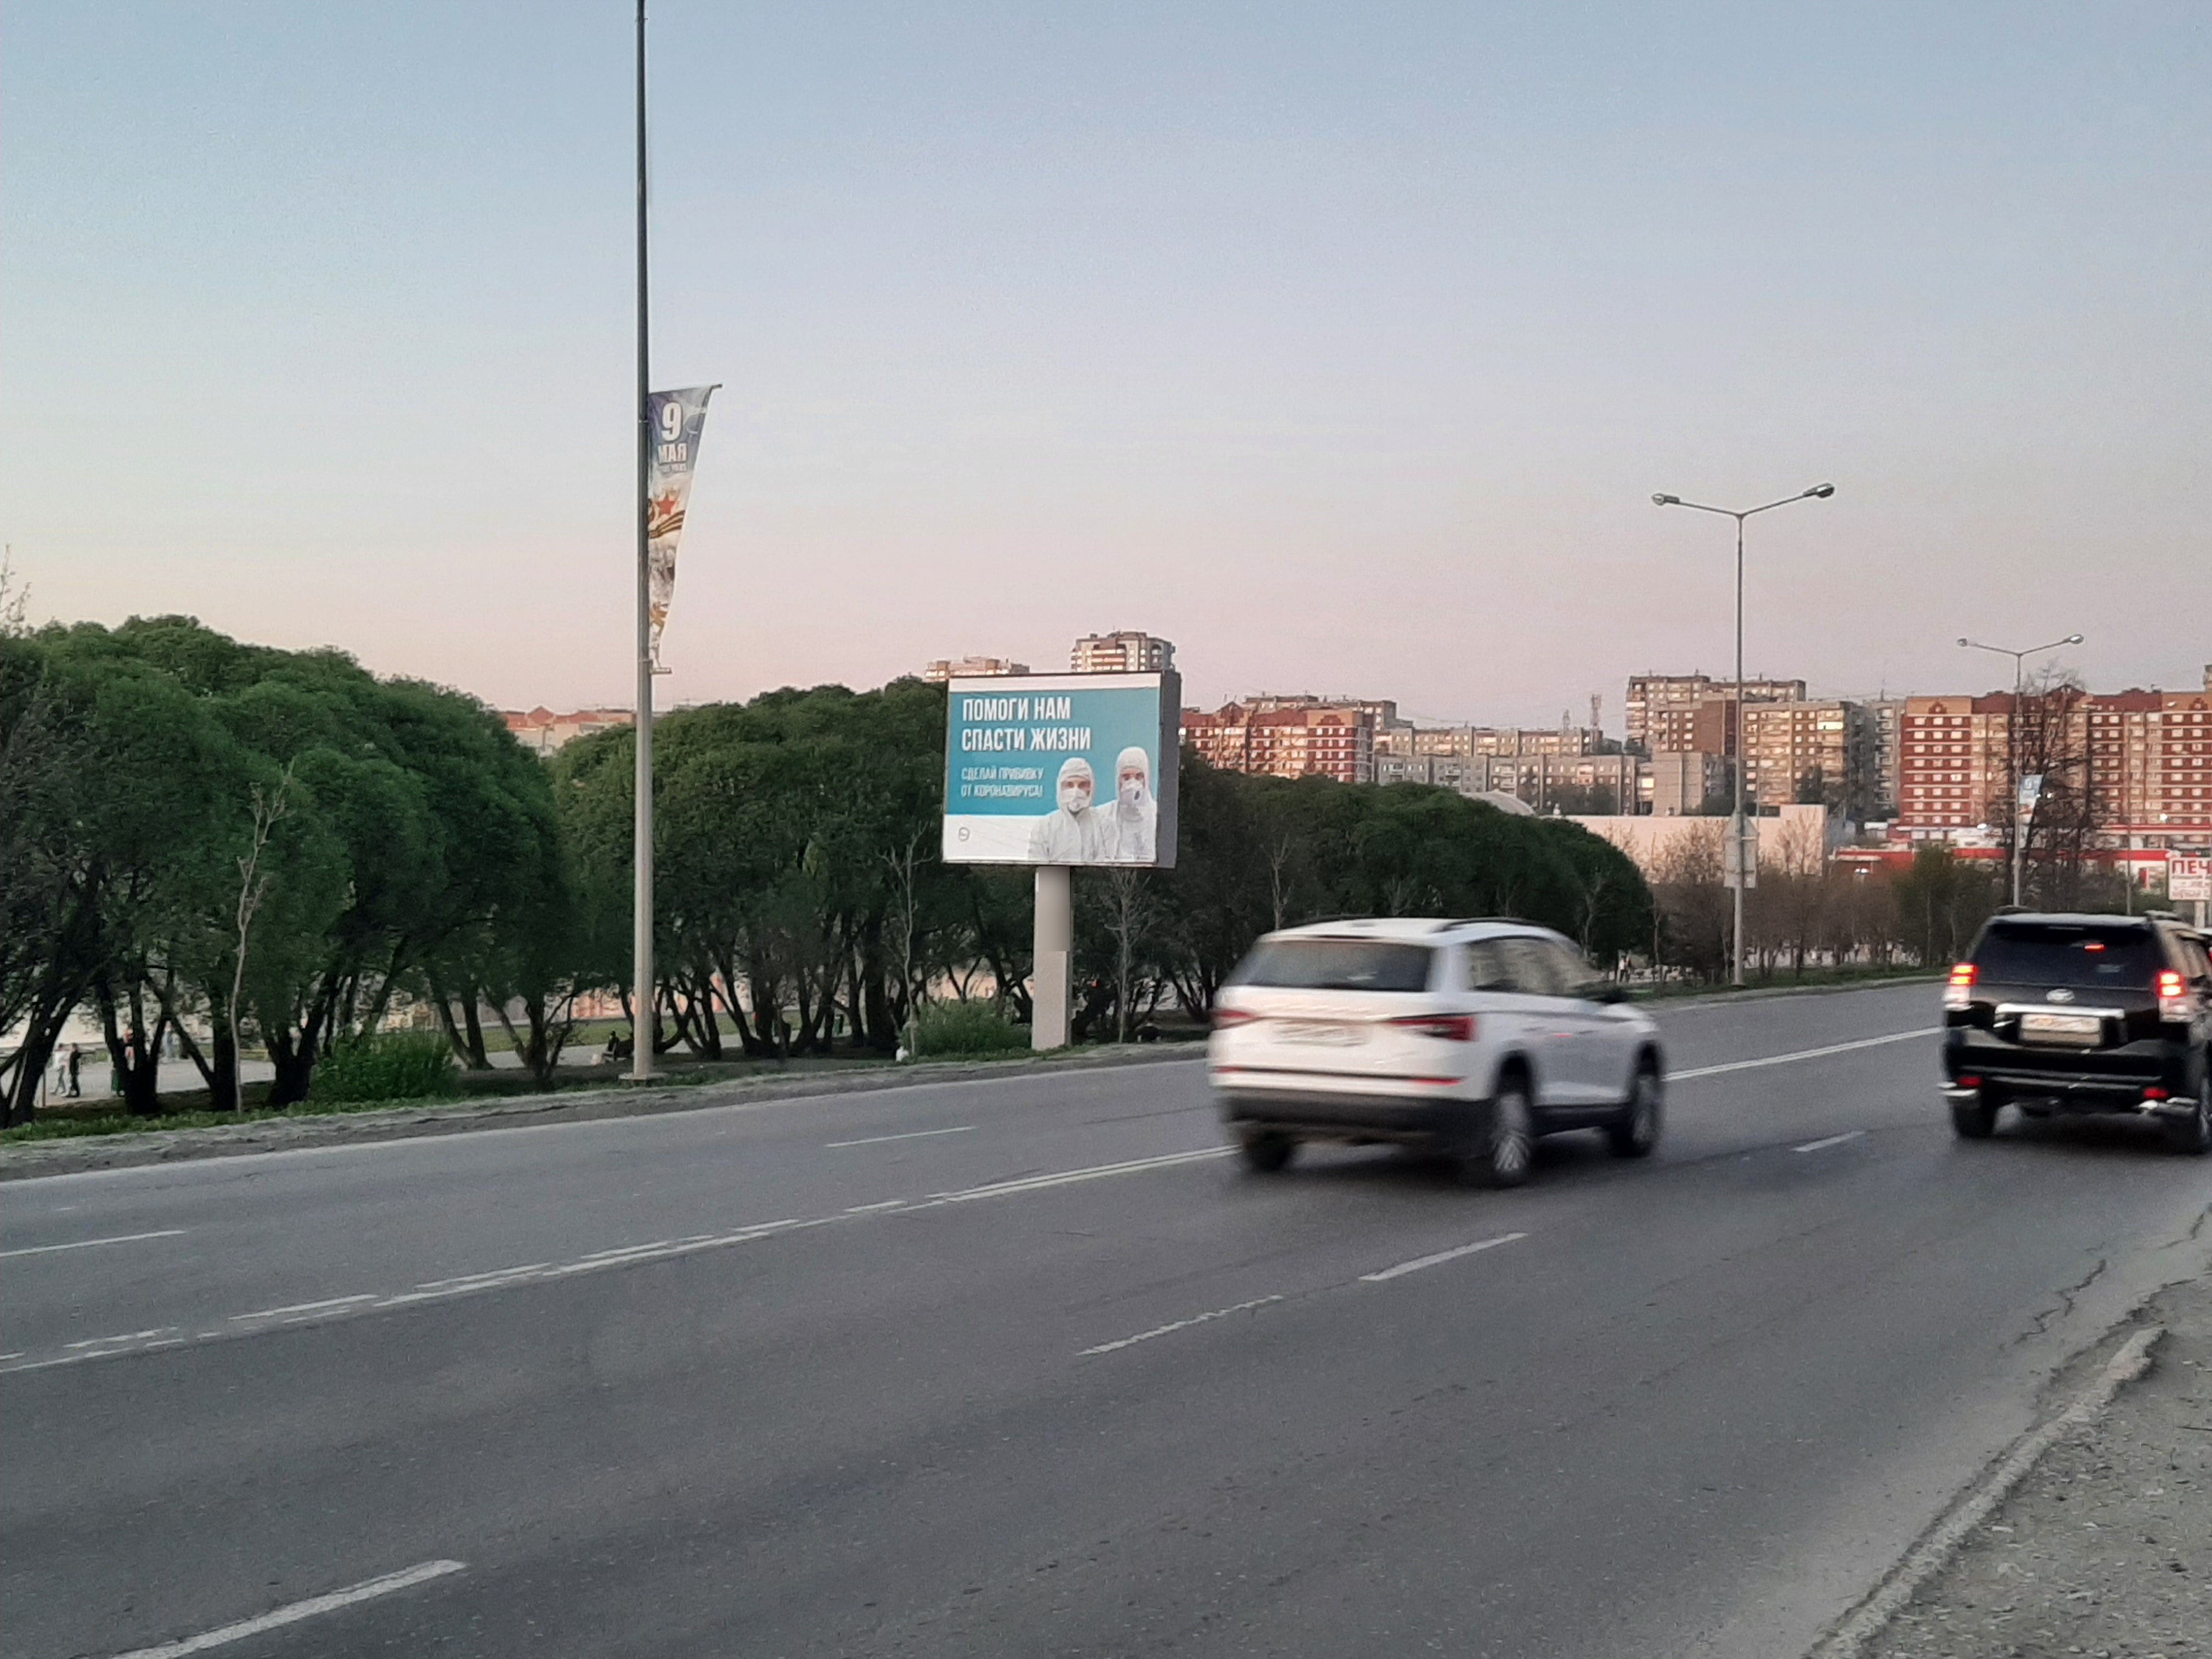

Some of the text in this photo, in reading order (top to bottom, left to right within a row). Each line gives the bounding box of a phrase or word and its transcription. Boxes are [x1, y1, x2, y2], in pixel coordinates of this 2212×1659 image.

[661, 402, 682, 442] 9
[658, 443, 687, 464] МАЯ
[962, 697, 1070, 721] ПОМОГИ НАМ
[962, 727, 1091, 751] СПАСТИ ЖИЗНИ
[961, 766, 997, 781] СДЕЛАЙ
[961, 785, 973, 798] ОТ
